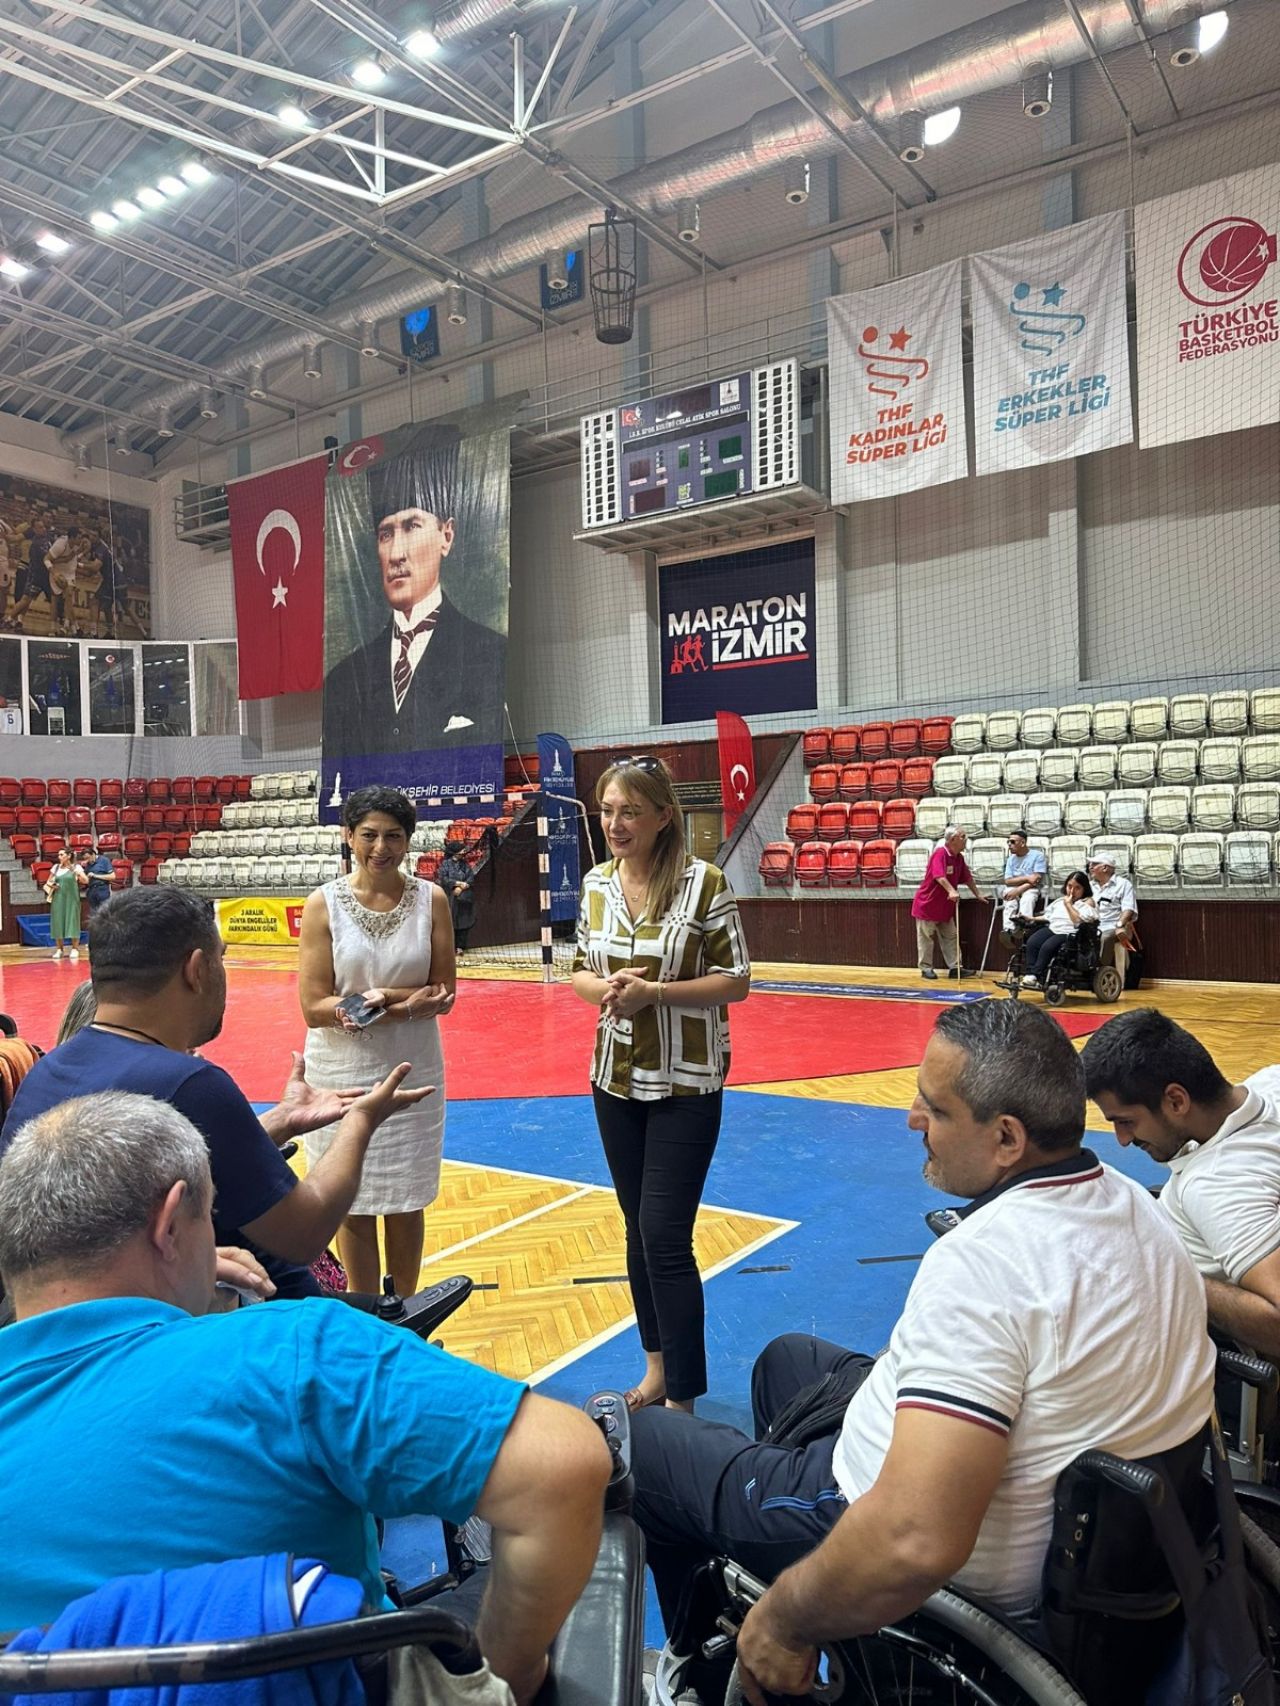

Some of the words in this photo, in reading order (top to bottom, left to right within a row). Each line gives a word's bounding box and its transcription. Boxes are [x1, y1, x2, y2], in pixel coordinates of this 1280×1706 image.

[1178, 299, 1278, 338] TÜRKİYE
[1179, 319, 1279, 352] BASKETBOL
[1179, 331, 1279, 363] FEDERASYONU
[1028, 362, 1070, 386] THF
[994, 404, 1062, 432] SÜPER
[1068, 386, 1111, 416] LİGİ
[997, 374, 1107, 413] ERKEKLER
[849, 412, 944, 447] KADINLAR
[877, 402, 913, 424] THF
[846, 441, 908, 465] SÜPER
[912, 424, 948, 453] LİGİ
[668, 592, 807, 638] MARATON
[440, 781, 496, 796] BELEDİYESİ
